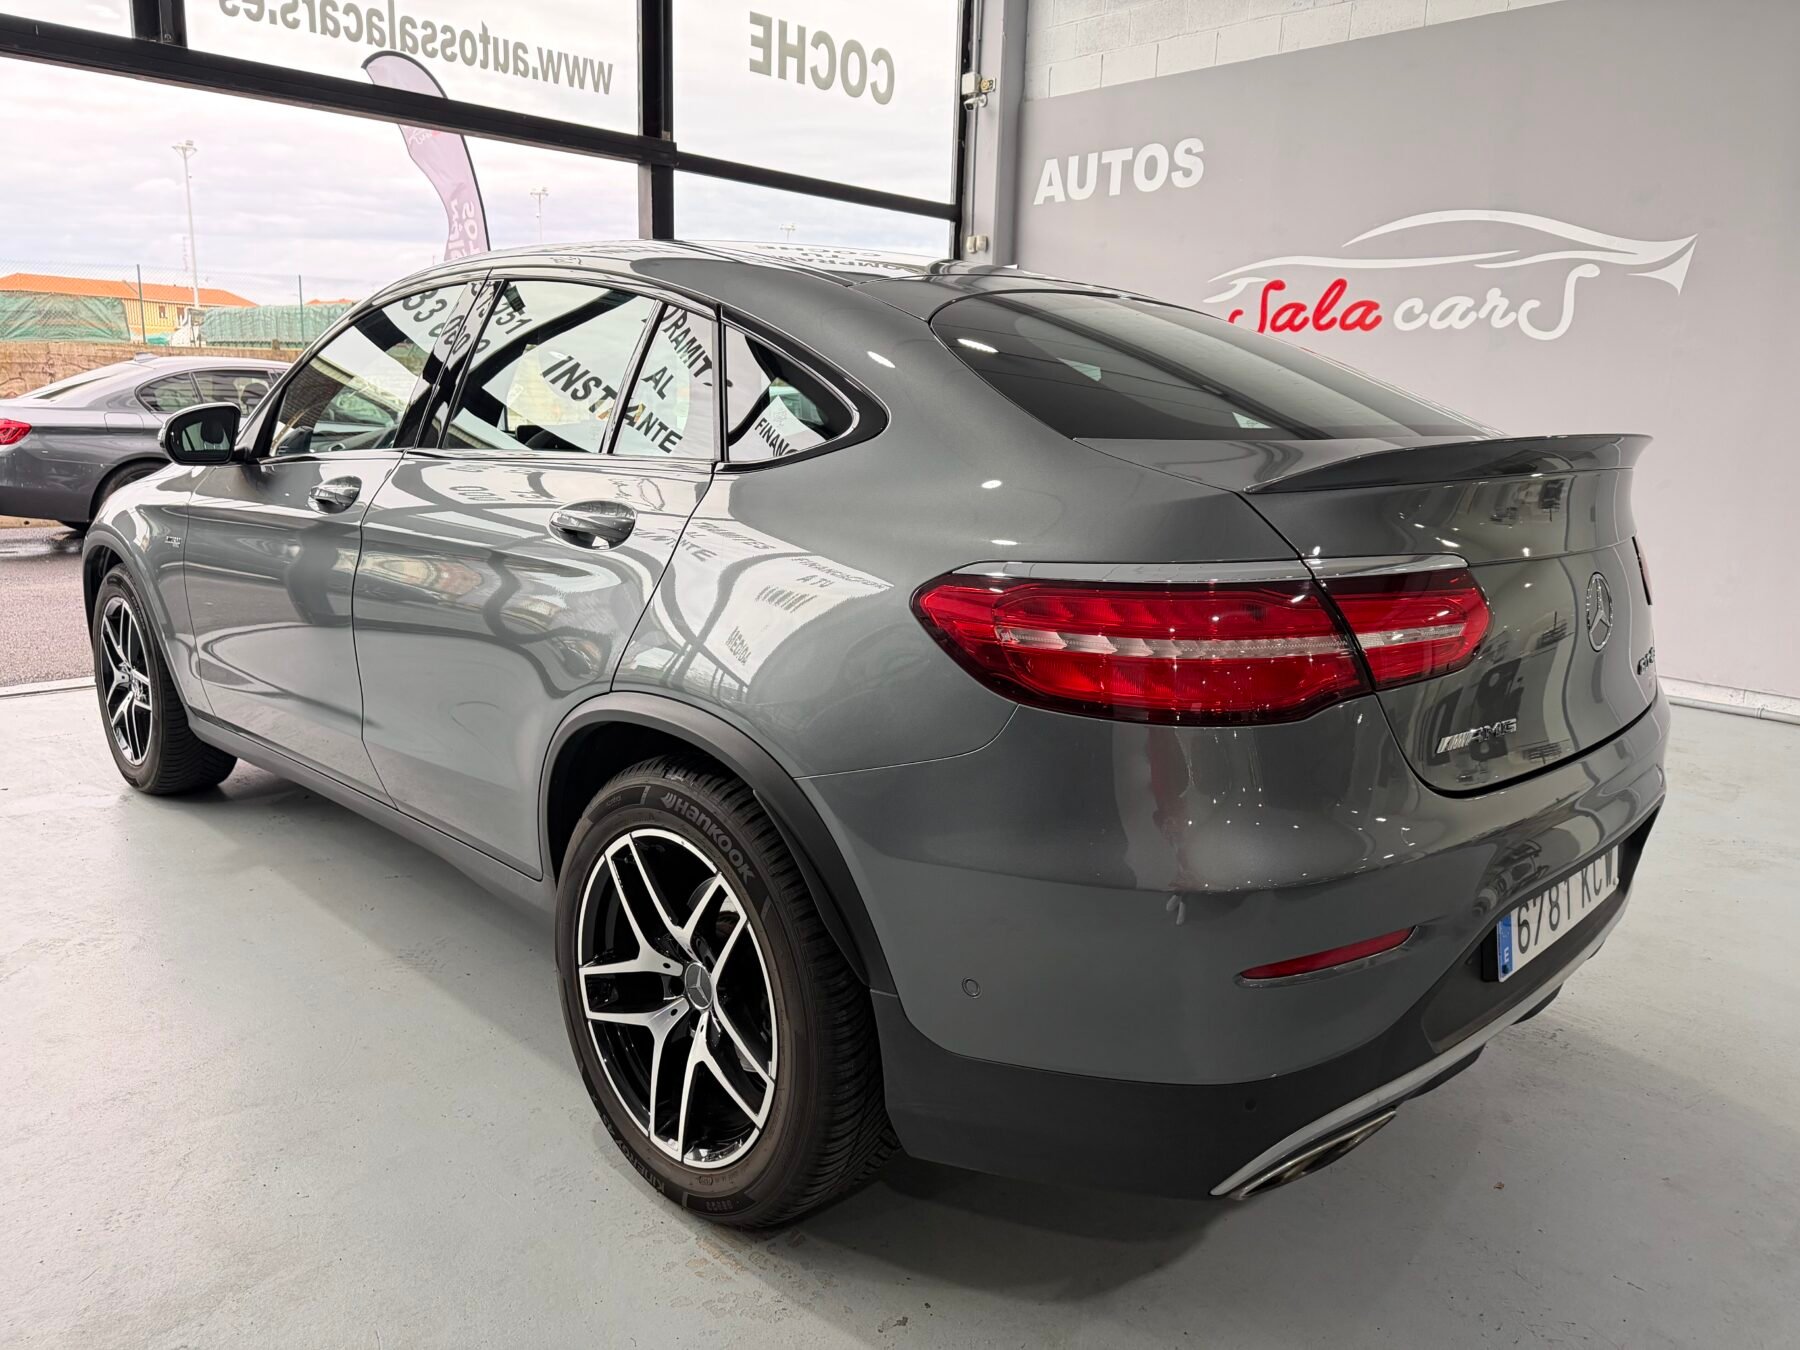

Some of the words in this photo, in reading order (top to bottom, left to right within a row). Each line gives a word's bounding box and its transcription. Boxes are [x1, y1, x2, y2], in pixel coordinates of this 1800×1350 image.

[1033, 137, 1205, 206] AUTOS
[1228, 278, 1383, 334] Sala
[641, 366, 674, 400] AL
[754, 417, 800, 457] FINAN
[1517, 878, 1571, 954] 6781
